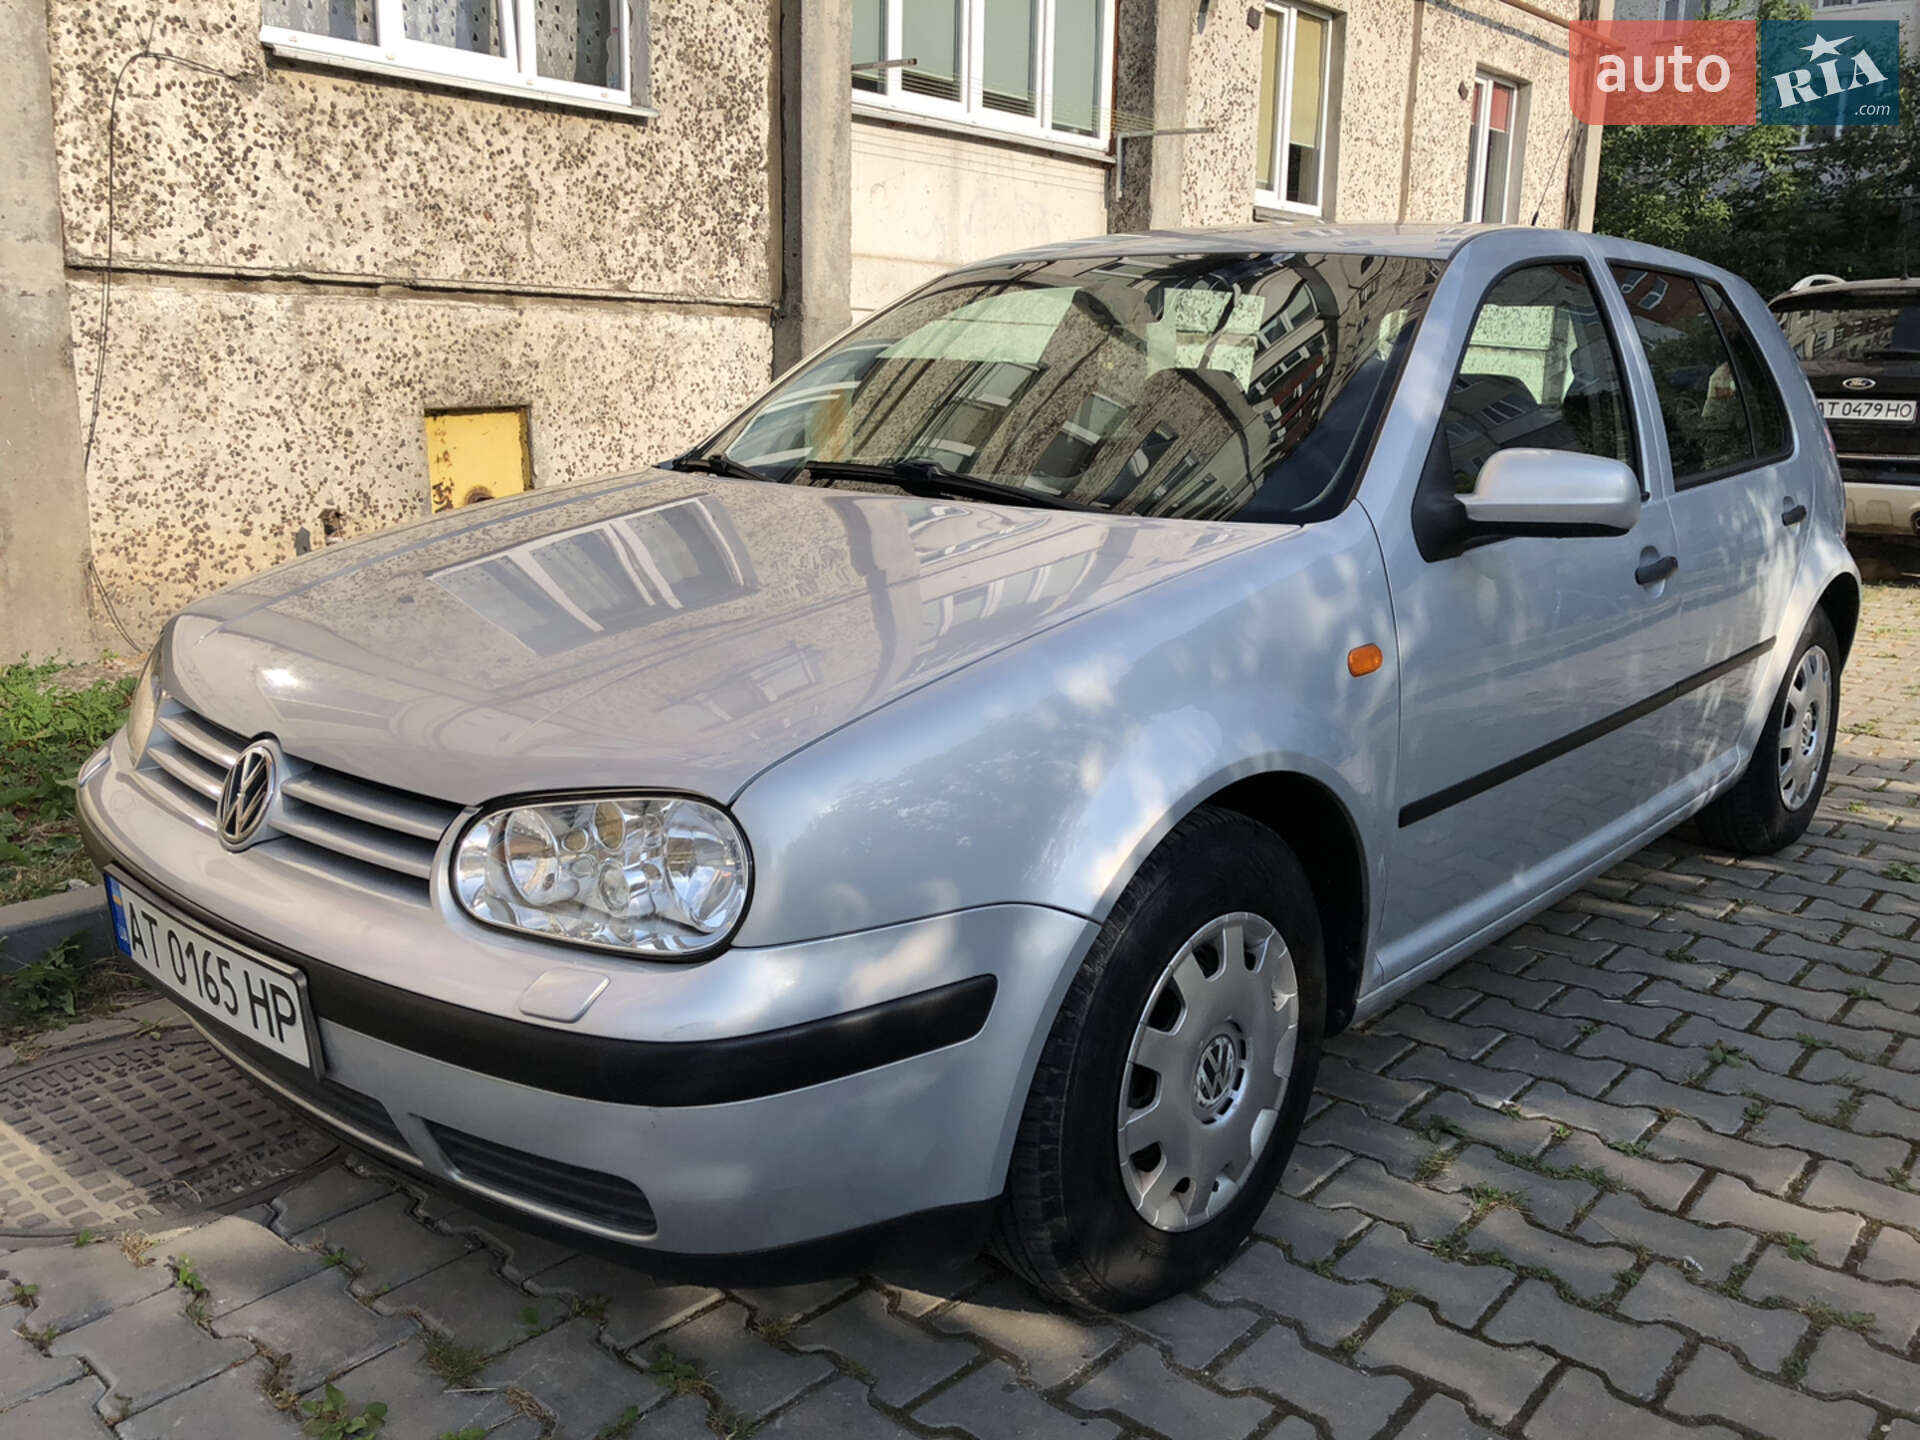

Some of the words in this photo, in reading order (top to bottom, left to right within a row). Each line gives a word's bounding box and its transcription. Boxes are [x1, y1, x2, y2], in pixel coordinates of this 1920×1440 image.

[1842, 402, 1884, 417] 0479
[1886, 403, 1912, 418] HO
[128, 901, 159, 969] AT
[167, 929, 239, 1016] 0165
[243, 970, 297, 1043] HP
